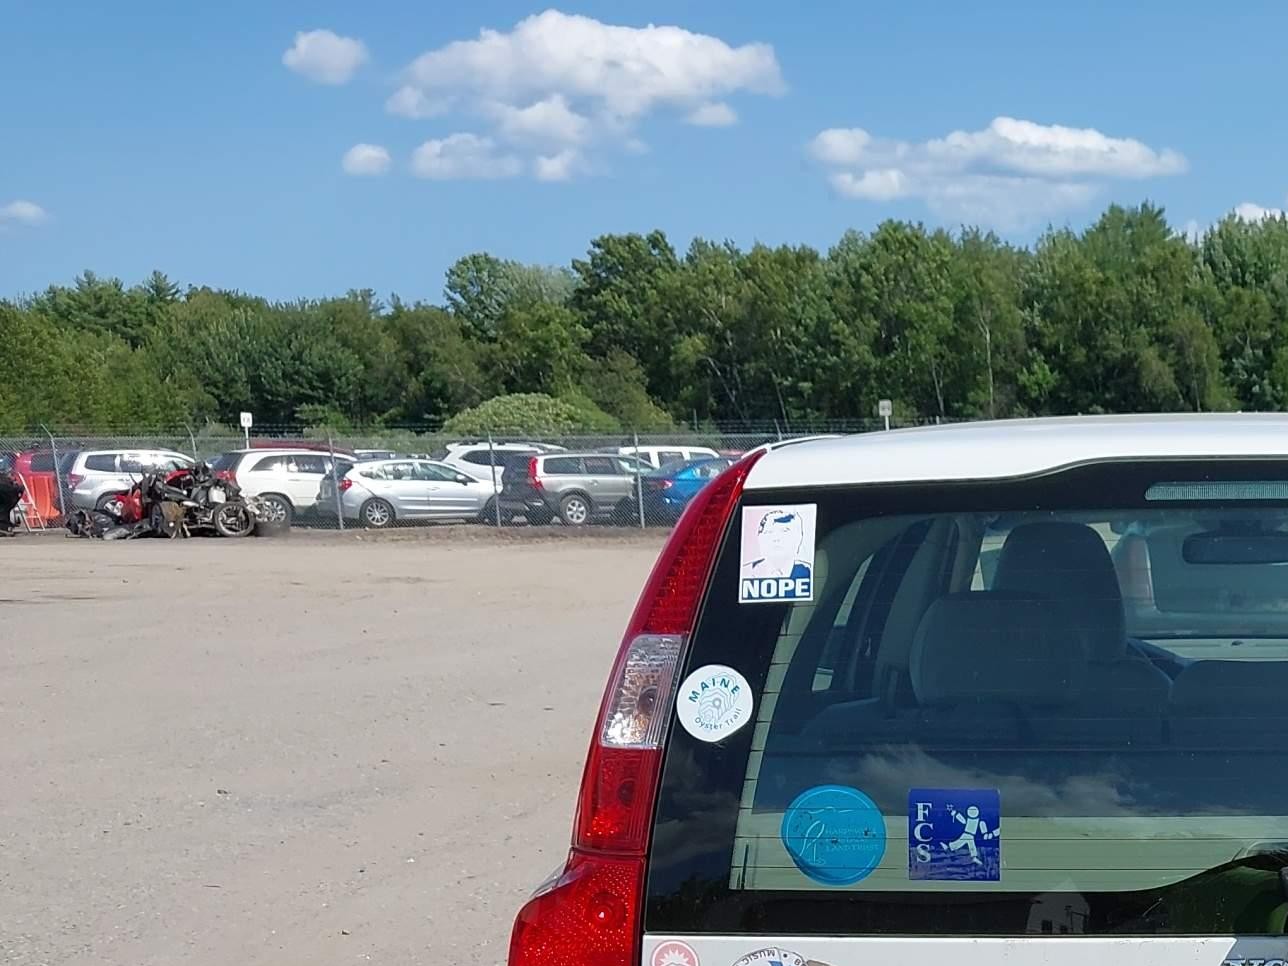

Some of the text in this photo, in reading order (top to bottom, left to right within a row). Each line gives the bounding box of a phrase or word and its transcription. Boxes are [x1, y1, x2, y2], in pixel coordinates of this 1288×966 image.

[742, 578, 810, 598] NOPE
[688, 678, 741, 703] MAINE
[694, 707, 743, 730] Oyster Trail
[741, 949, 776, 966] MUSIC
